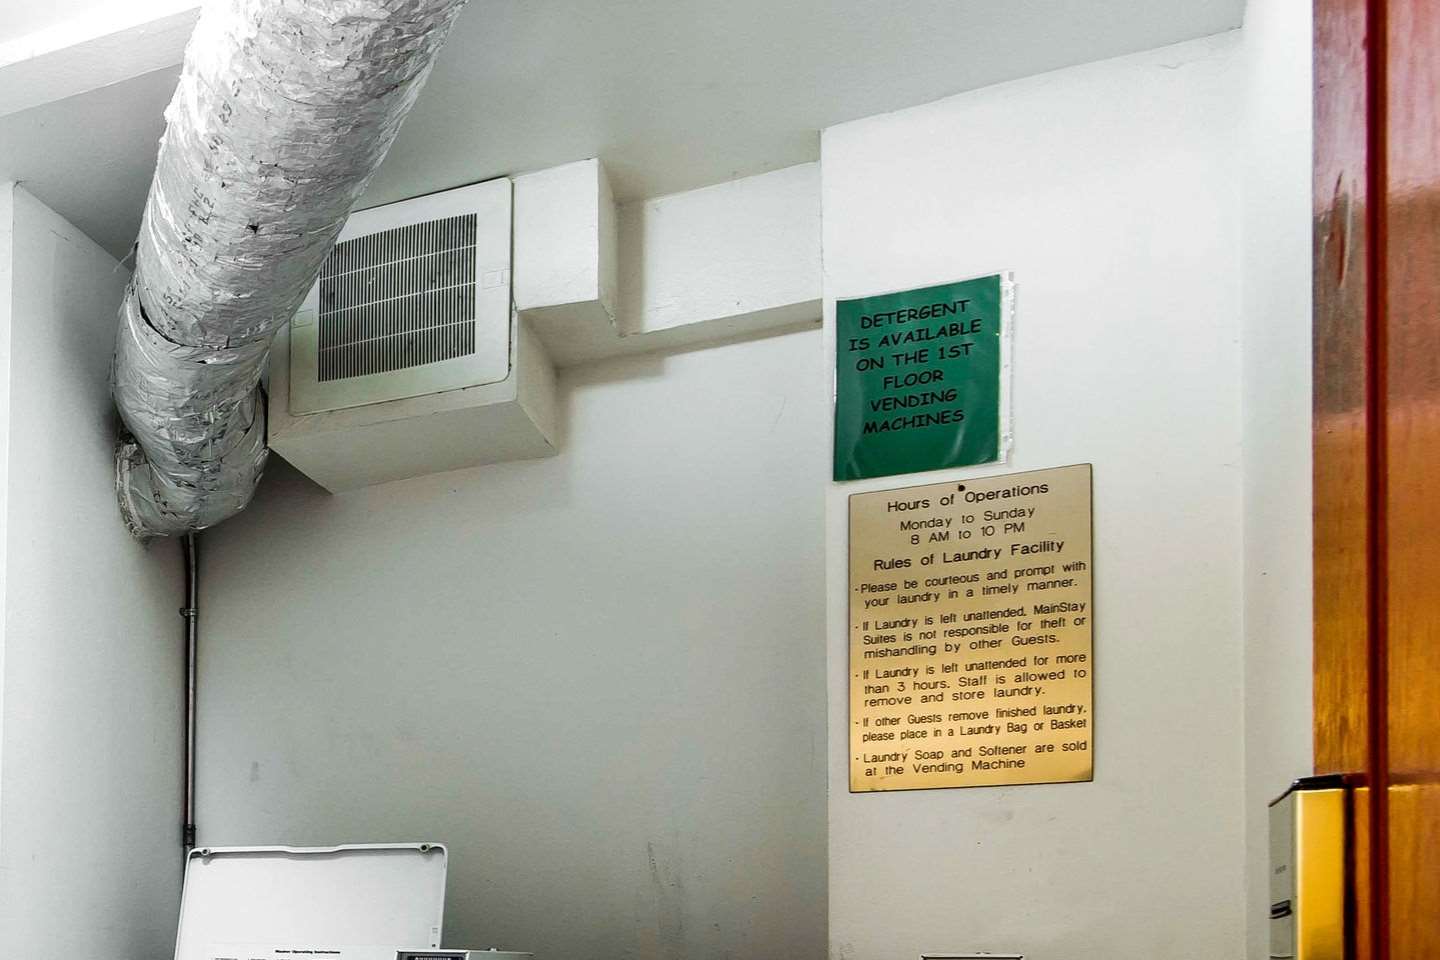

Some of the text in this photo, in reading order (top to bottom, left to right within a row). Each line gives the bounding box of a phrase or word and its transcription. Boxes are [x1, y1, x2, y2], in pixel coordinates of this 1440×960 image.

[861, 300, 970, 329] DETERGENT
[849, 319, 982, 351] IS AVAILABLE
[856, 343, 974, 371] ON THE 1ST
[884, 369, 944, 390] FLOOR
[871, 388, 958, 412] VENDING
[864, 409, 965, 434] MACHINES
[887, 483, 1049, 512] Hours of Operations
[900, 507, 1035, 531] Monday to Sunday
[911, 523, 1024, 545] 8 AM to 10 PM
[874, 540, 1064, 571] Rules of Laundry Facility
[861, 561, 1086, 593] Please be courteous and prompt with
[864, 599, 889, 609] your
[897, 592, 940, 604] laundry
[948, 590, 958, 599] in
[982, 584, 1018, 596] timely
[1027, 578, 1077, 591] manner.
[863, 621, 869, 631] If
[875, 617, 918, 630] Laundry
[925, 616, 933, 626] is
[940, 613, 956, 624] left
[1034, 602, 1085, 616] MainStay
[864, 617, 1086, 645] Suites is not responsible for theft or
[864, 634, 1060, 659] mishandling by other Guests.
[863, 653, 1086, 680] If Laundry is left unattended for more
[864, 683, 889, 694] than
[897, 682, 905, 692] 3
[958, 675, 987, 687] Staff
[995, 675, 1005, 684] is
[1015, 669, 1065, 683] allowed
[1074, 668, 1086, 678] to
[864, 686, 1045, 707] remove and store laundry.
[863, 718, 868, 727] If
[875, 716, 901, 726] other
[907, 713, 942, 725] Guests
[948, 710, 989, 722] remove
[996, 707, 1036, 718] finished
[862, 732, 894, 744] please
[901, 729, 927, 741] place
[933, 728, 941, 737] in
[960, 724, 1000, 736] Laundry
[1007, 723, 1027, 734] Bag
[1034, 722, 1044, 731] or
[1051, 719, 1086, 730] Basket
[864, 740, 1087, 763] Laundry Soap and Softener are sold
[865, 758, 1025, 776] at the Vending Machine
